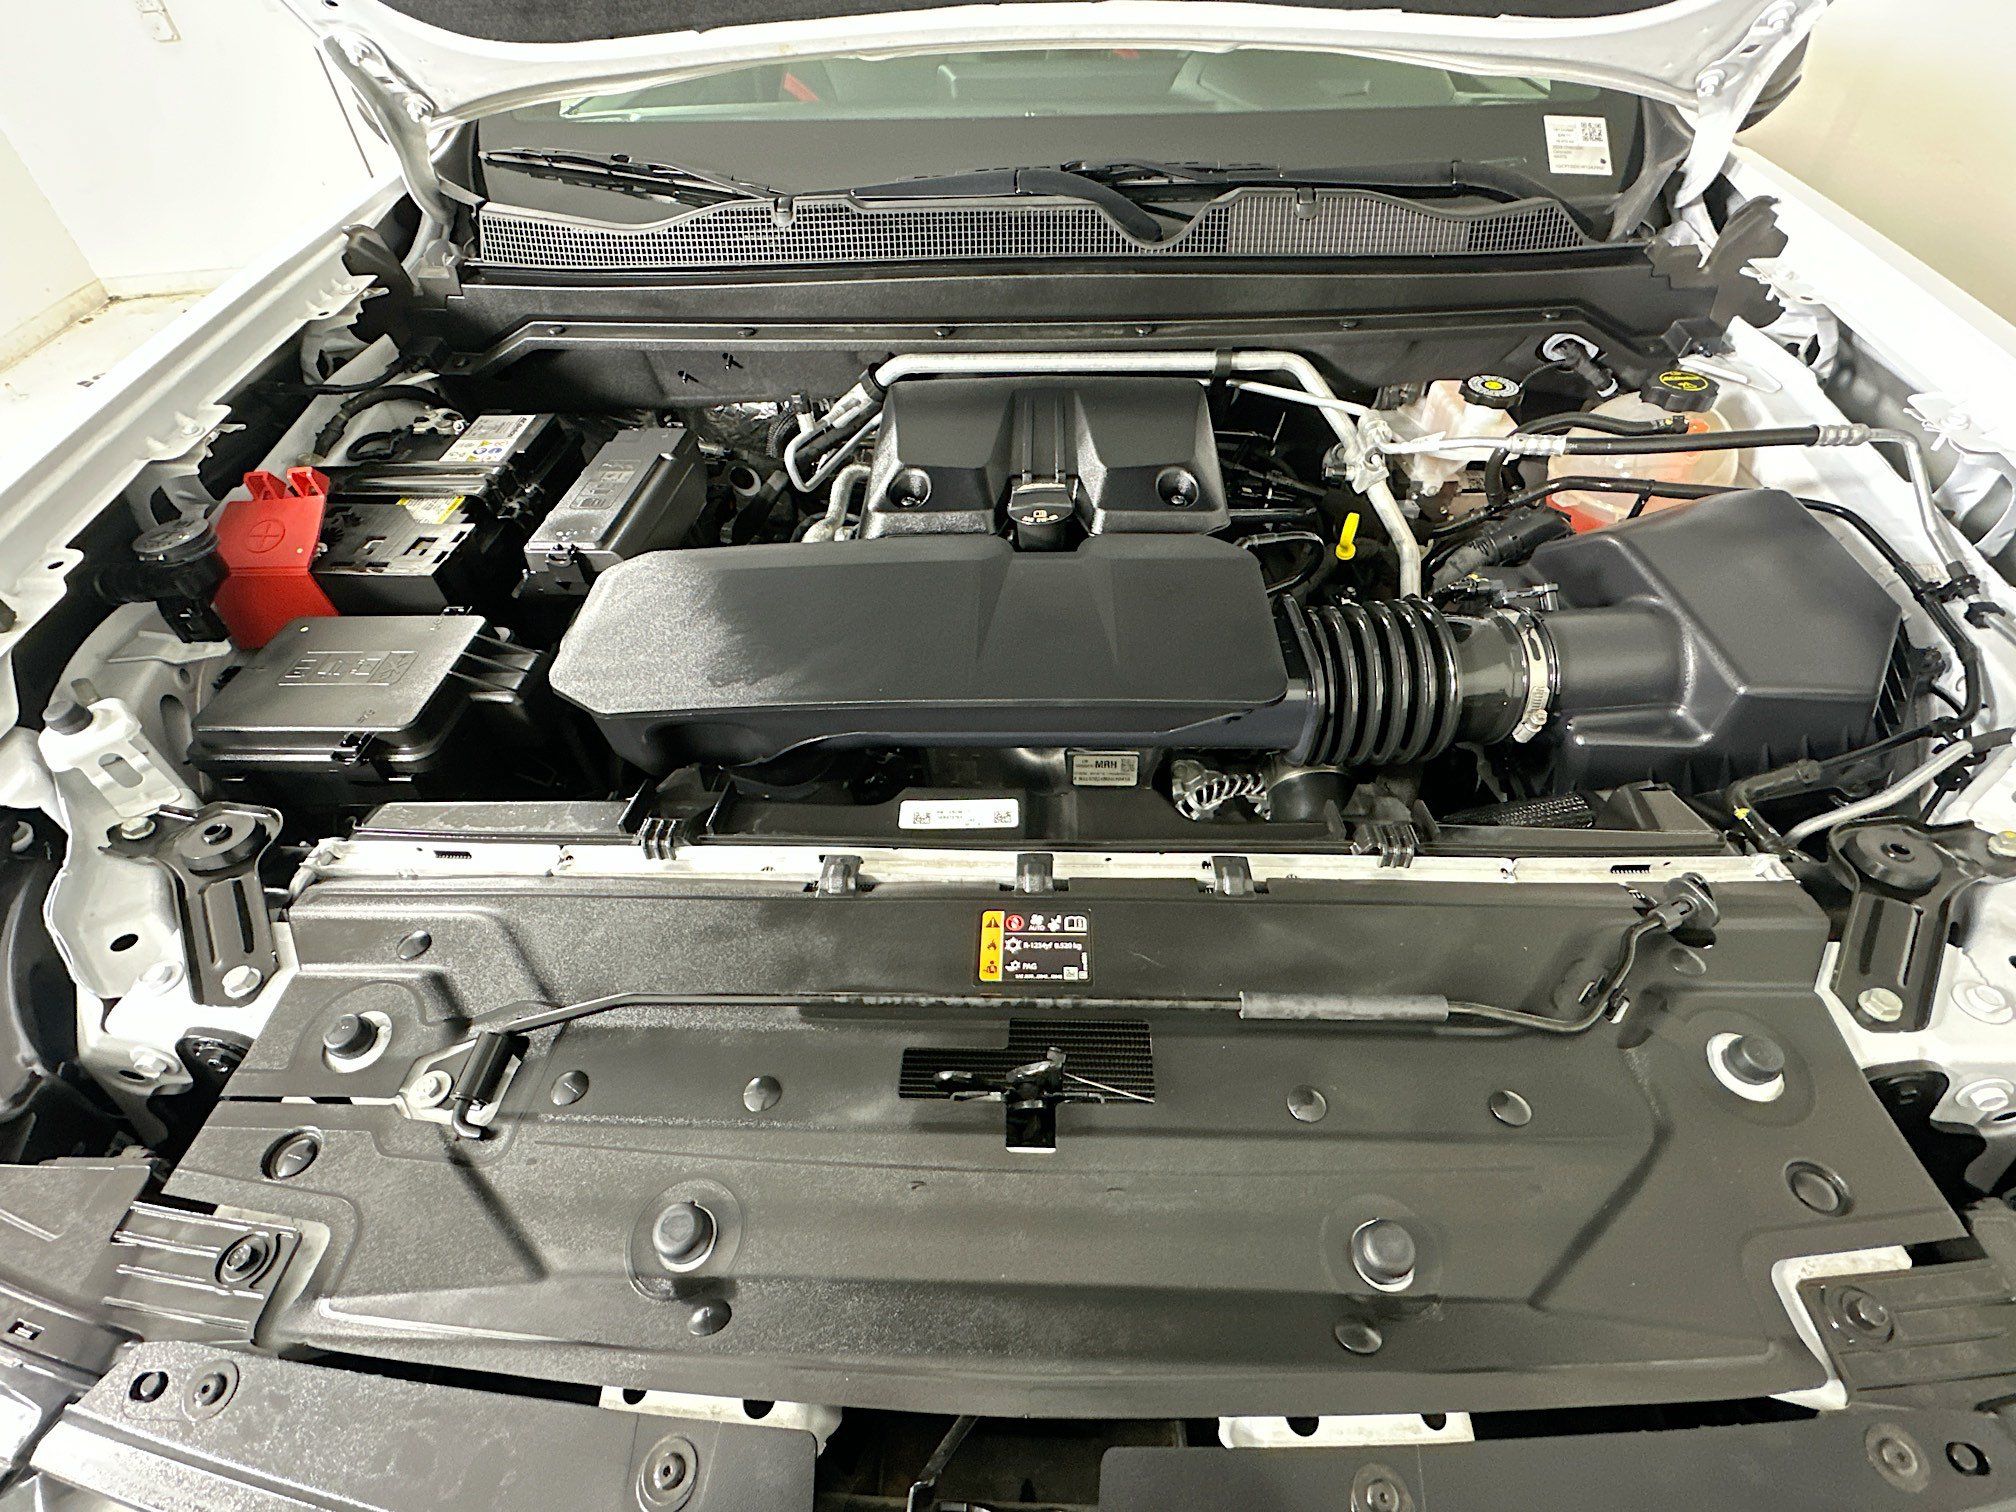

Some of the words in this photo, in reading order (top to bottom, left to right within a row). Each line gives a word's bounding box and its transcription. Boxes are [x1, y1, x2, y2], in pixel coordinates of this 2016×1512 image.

[1023, 941, 1053, 950] R-1234yf
[1073, 942, 1082, 951] kg
[1022, 962, 1038, 970] PAG
